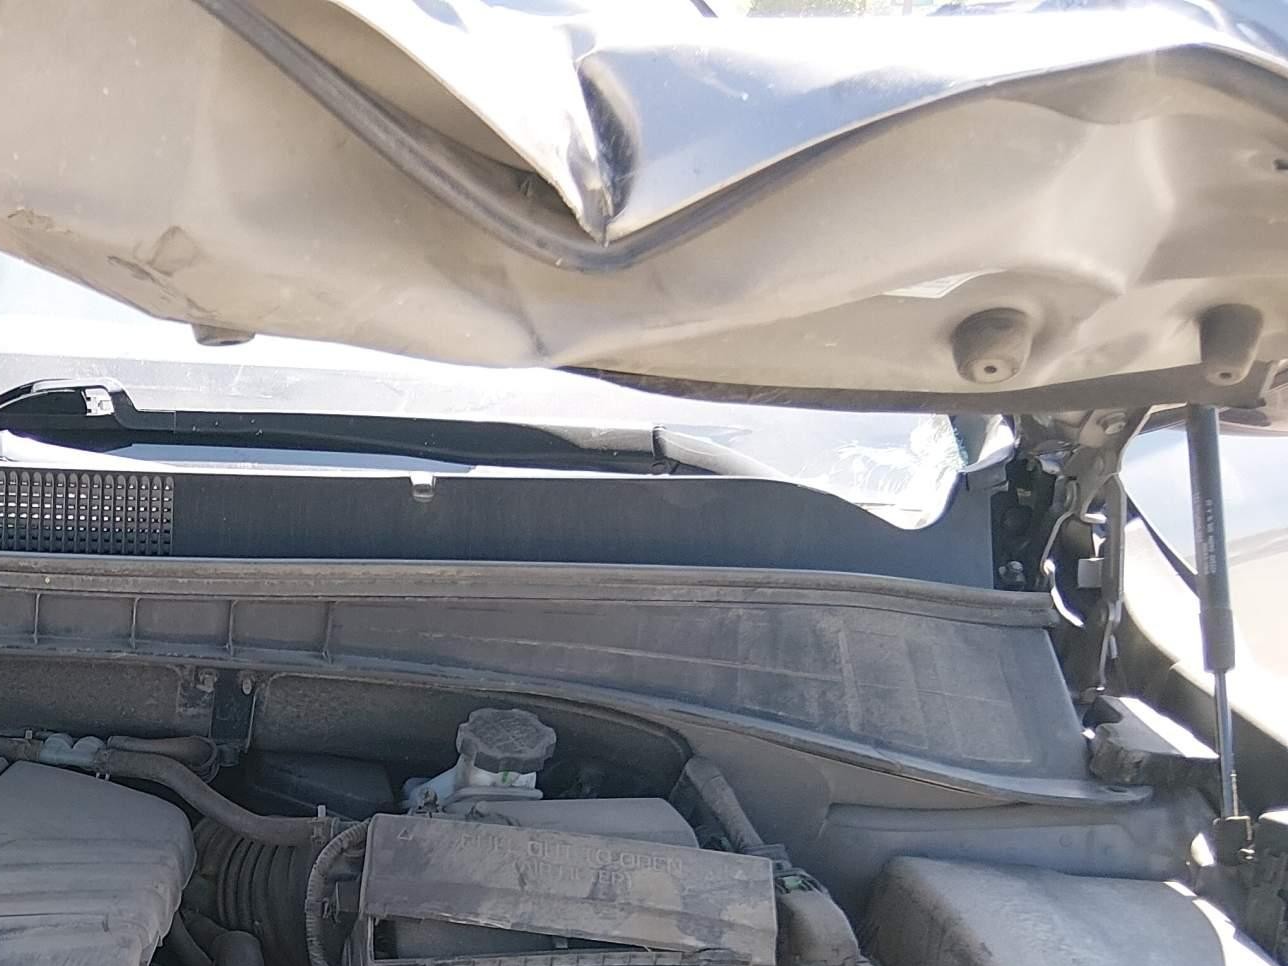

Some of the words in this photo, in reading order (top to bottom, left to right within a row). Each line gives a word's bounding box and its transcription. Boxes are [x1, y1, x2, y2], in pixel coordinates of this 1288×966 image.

[528, 839, 574, 860] OUT
[584, 847, 615, 867] TO
[619, 852, 682, 874] OPEN
